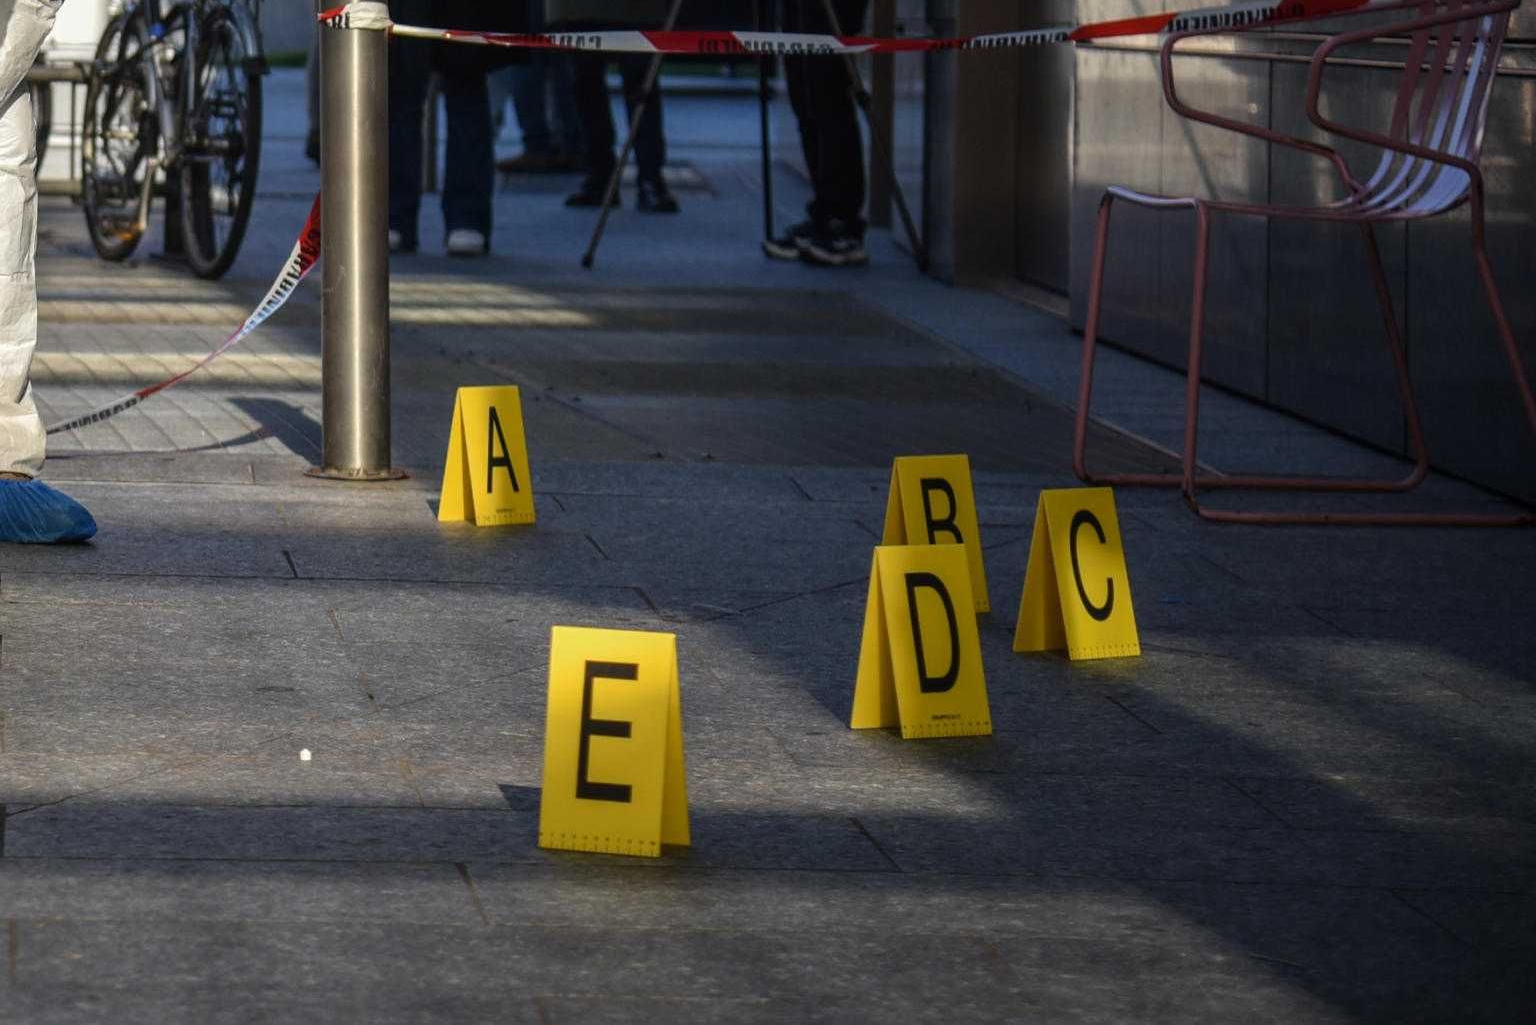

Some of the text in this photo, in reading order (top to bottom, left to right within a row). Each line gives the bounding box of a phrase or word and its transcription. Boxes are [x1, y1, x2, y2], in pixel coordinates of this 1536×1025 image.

[486, 405, 520, 494] A
[1069, 509, 1115, 622] C
[904, 572, 961, 694] D
[576, 660, 639, 804] E
